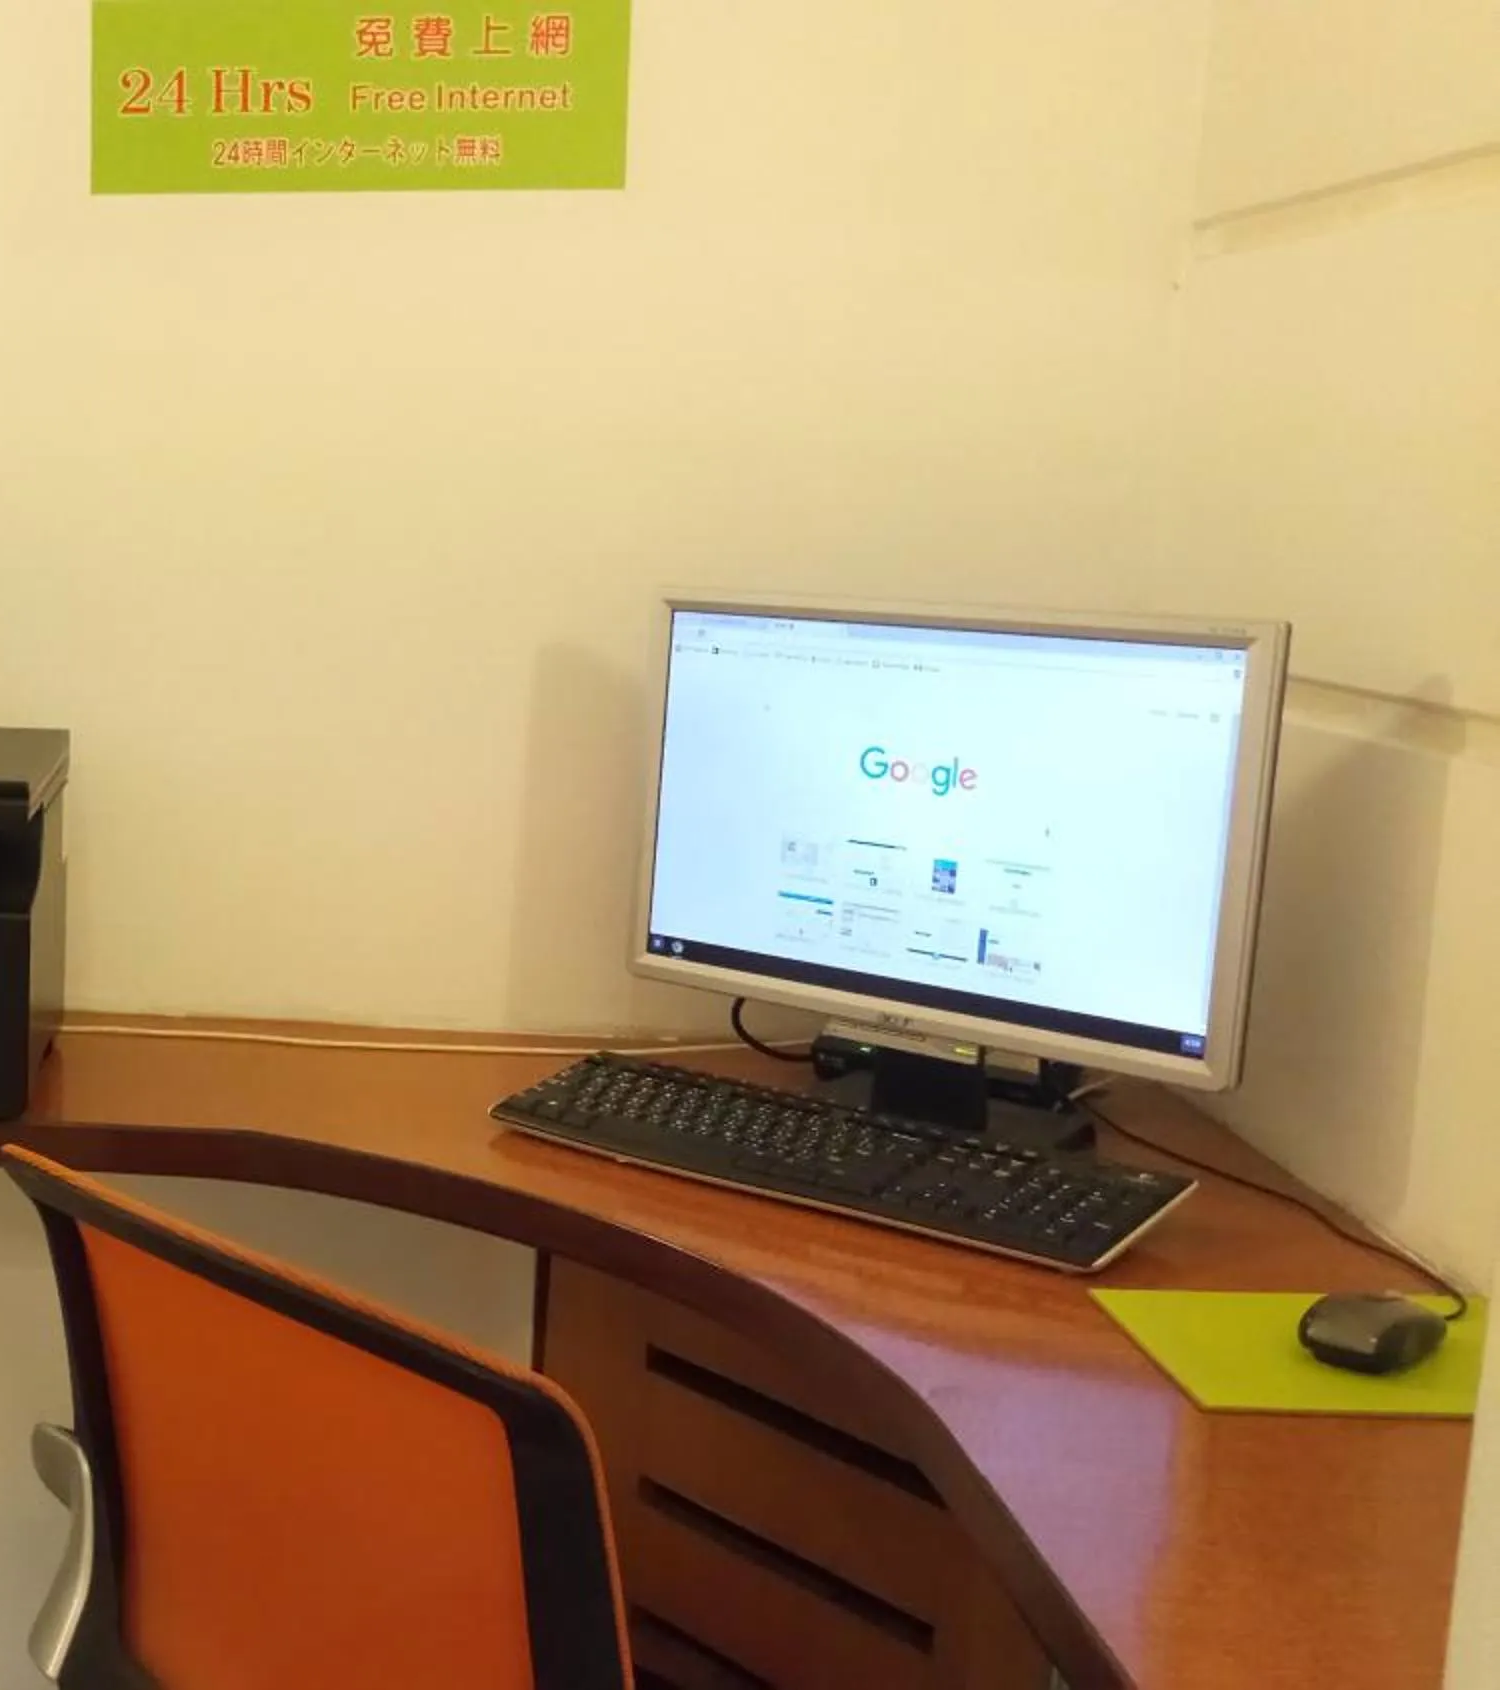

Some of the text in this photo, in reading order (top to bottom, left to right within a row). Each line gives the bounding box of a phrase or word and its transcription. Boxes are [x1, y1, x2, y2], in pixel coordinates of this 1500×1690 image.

[120, 68, 312, 115] 24 Hrs
[351, 82, 571, 111] Free Internet
[212, 138, 501, 167] 24時間インターネット無料
[859, 746, 979, 796] Google
